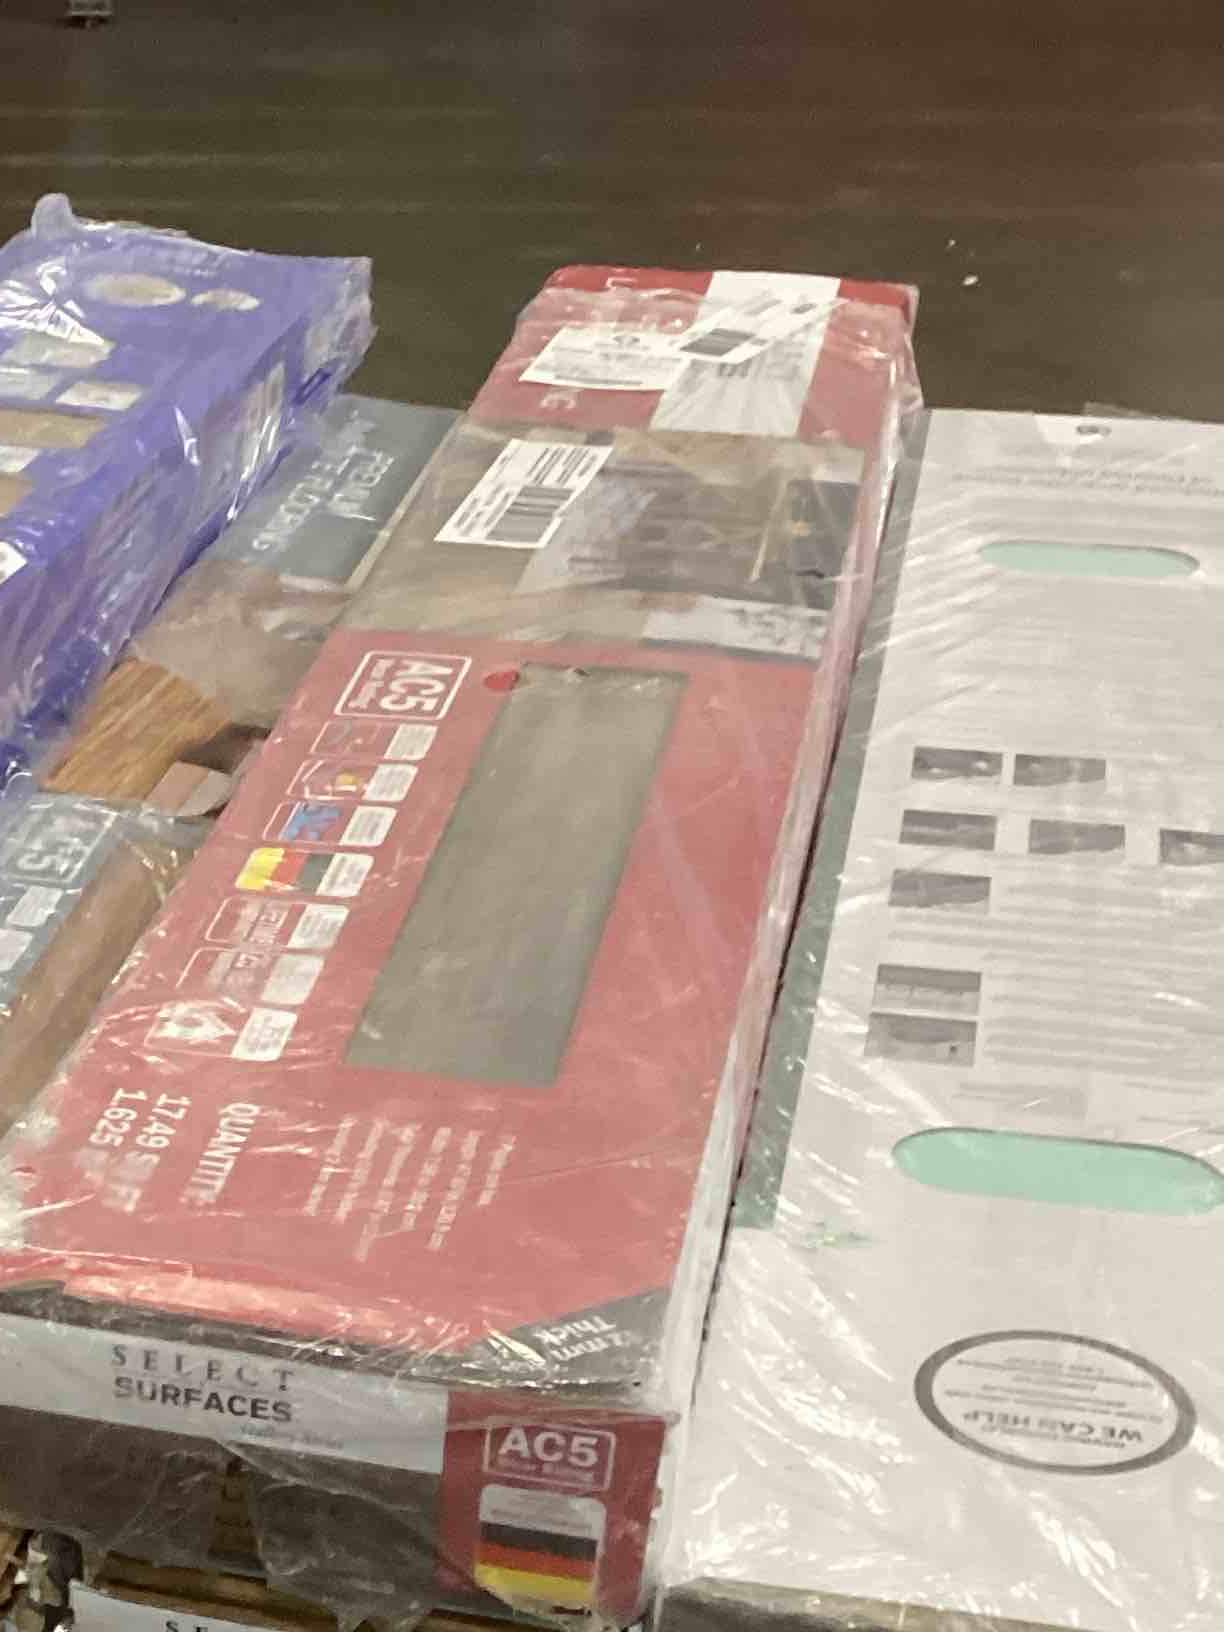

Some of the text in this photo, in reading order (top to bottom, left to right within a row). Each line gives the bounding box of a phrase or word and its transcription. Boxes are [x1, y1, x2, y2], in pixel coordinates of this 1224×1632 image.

[89, 1087, 148, 1147] 1.625
[136, 1093, 192, 1149] 17.49
[111, 1344, 296, 1392] SELECT
[114, 1376, 294, 1423] SURFACES
[498, 1428, 601, 1469] AC5
